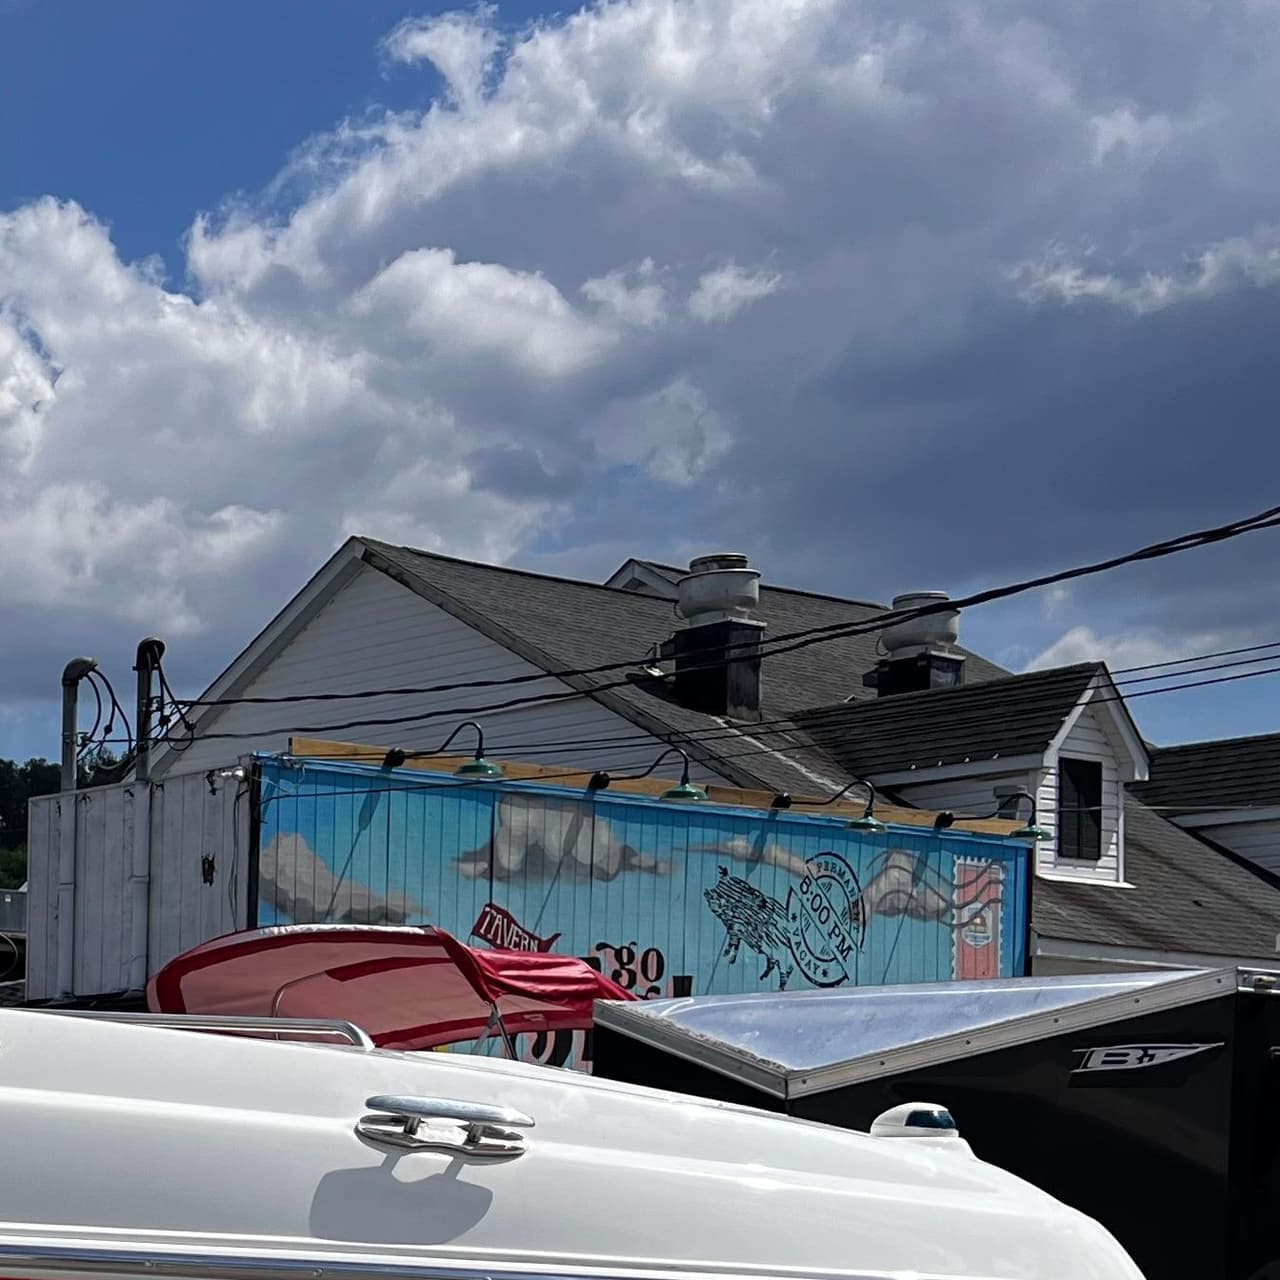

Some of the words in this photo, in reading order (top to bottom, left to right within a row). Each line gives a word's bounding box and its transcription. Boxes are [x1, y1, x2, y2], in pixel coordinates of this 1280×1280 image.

[479, 906, 539, 953] TAVERN
[799, 875, 830, 925] 8:00
[827, 920, 854, 962] PM
[792, 926, 820, 975] VACAY
